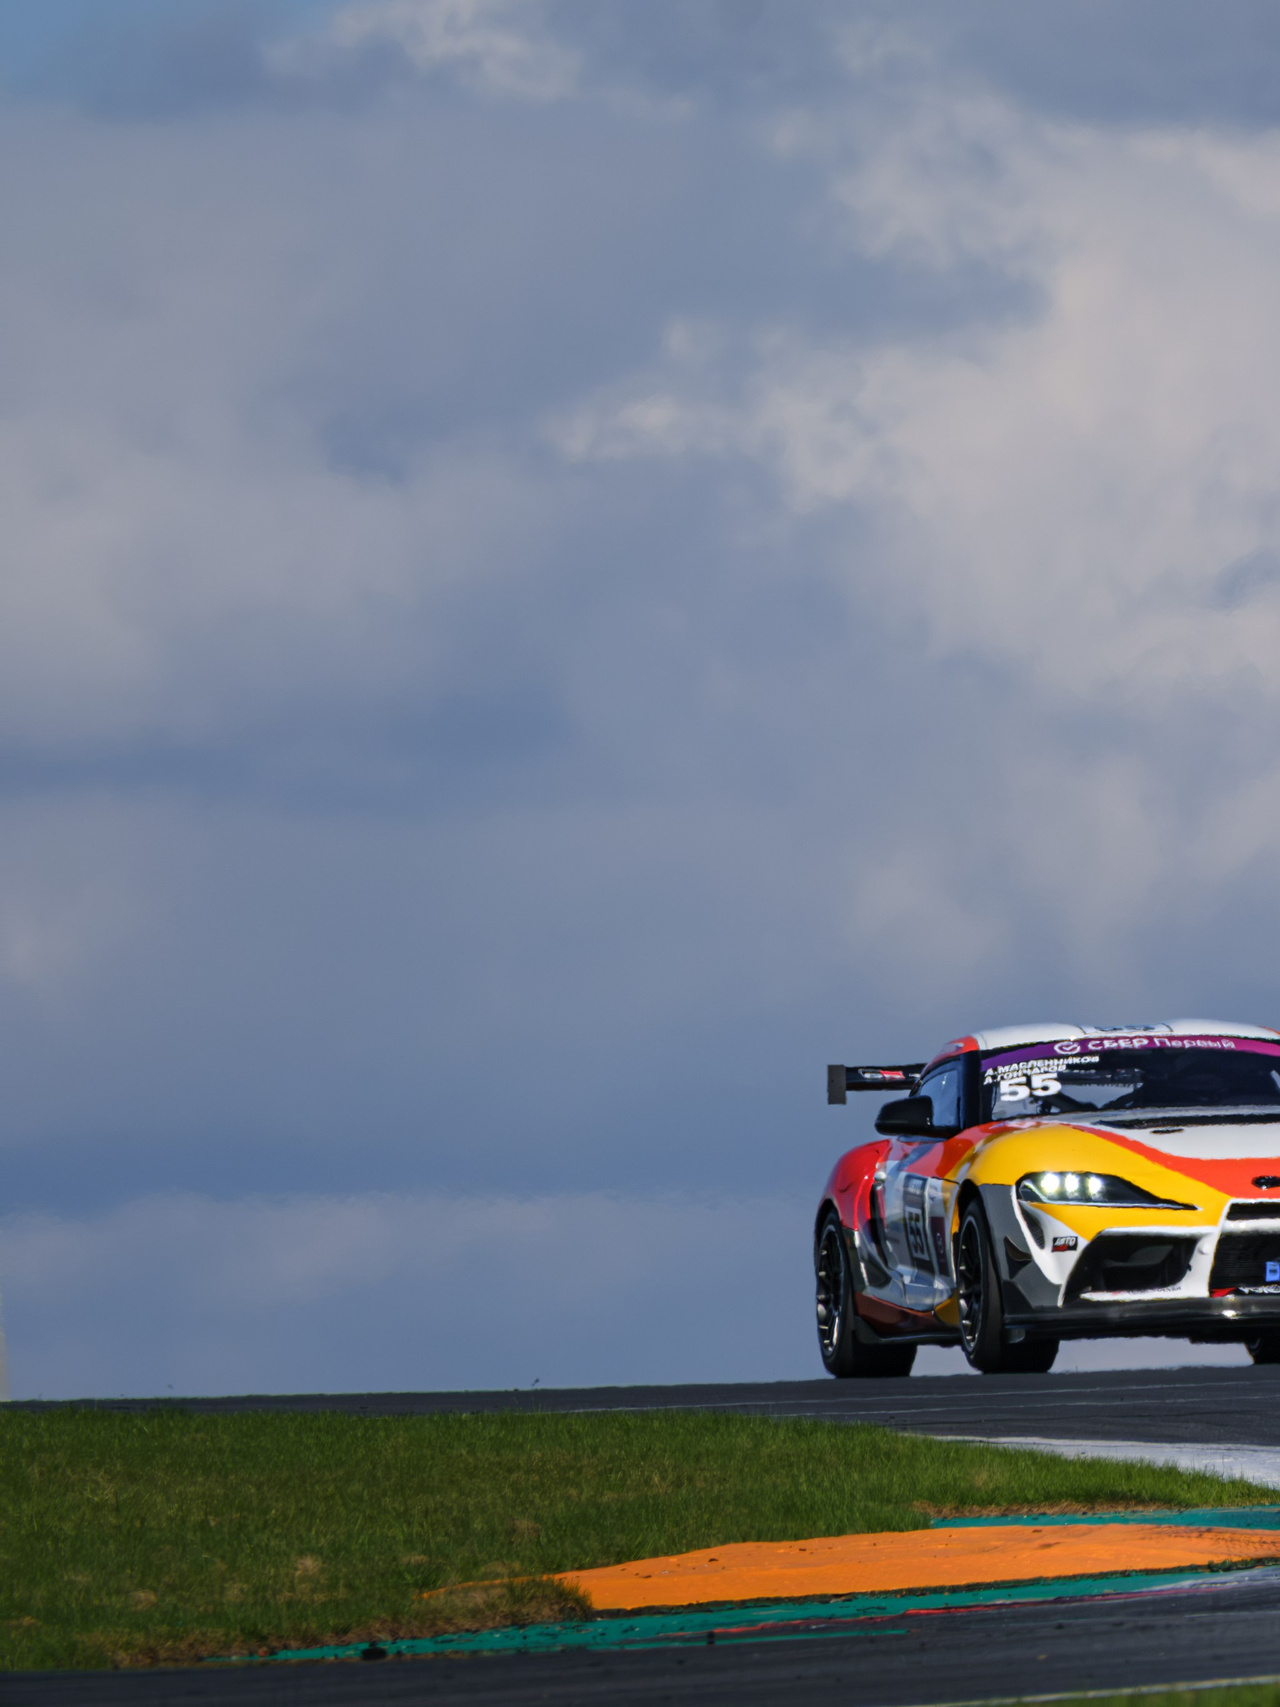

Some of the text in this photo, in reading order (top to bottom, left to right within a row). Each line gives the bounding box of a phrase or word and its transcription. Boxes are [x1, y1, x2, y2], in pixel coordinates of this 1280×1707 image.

[1088, 1037, 1236, 1051] СБЕР Первый
[1000, 1073, 1062, 1102] 55
